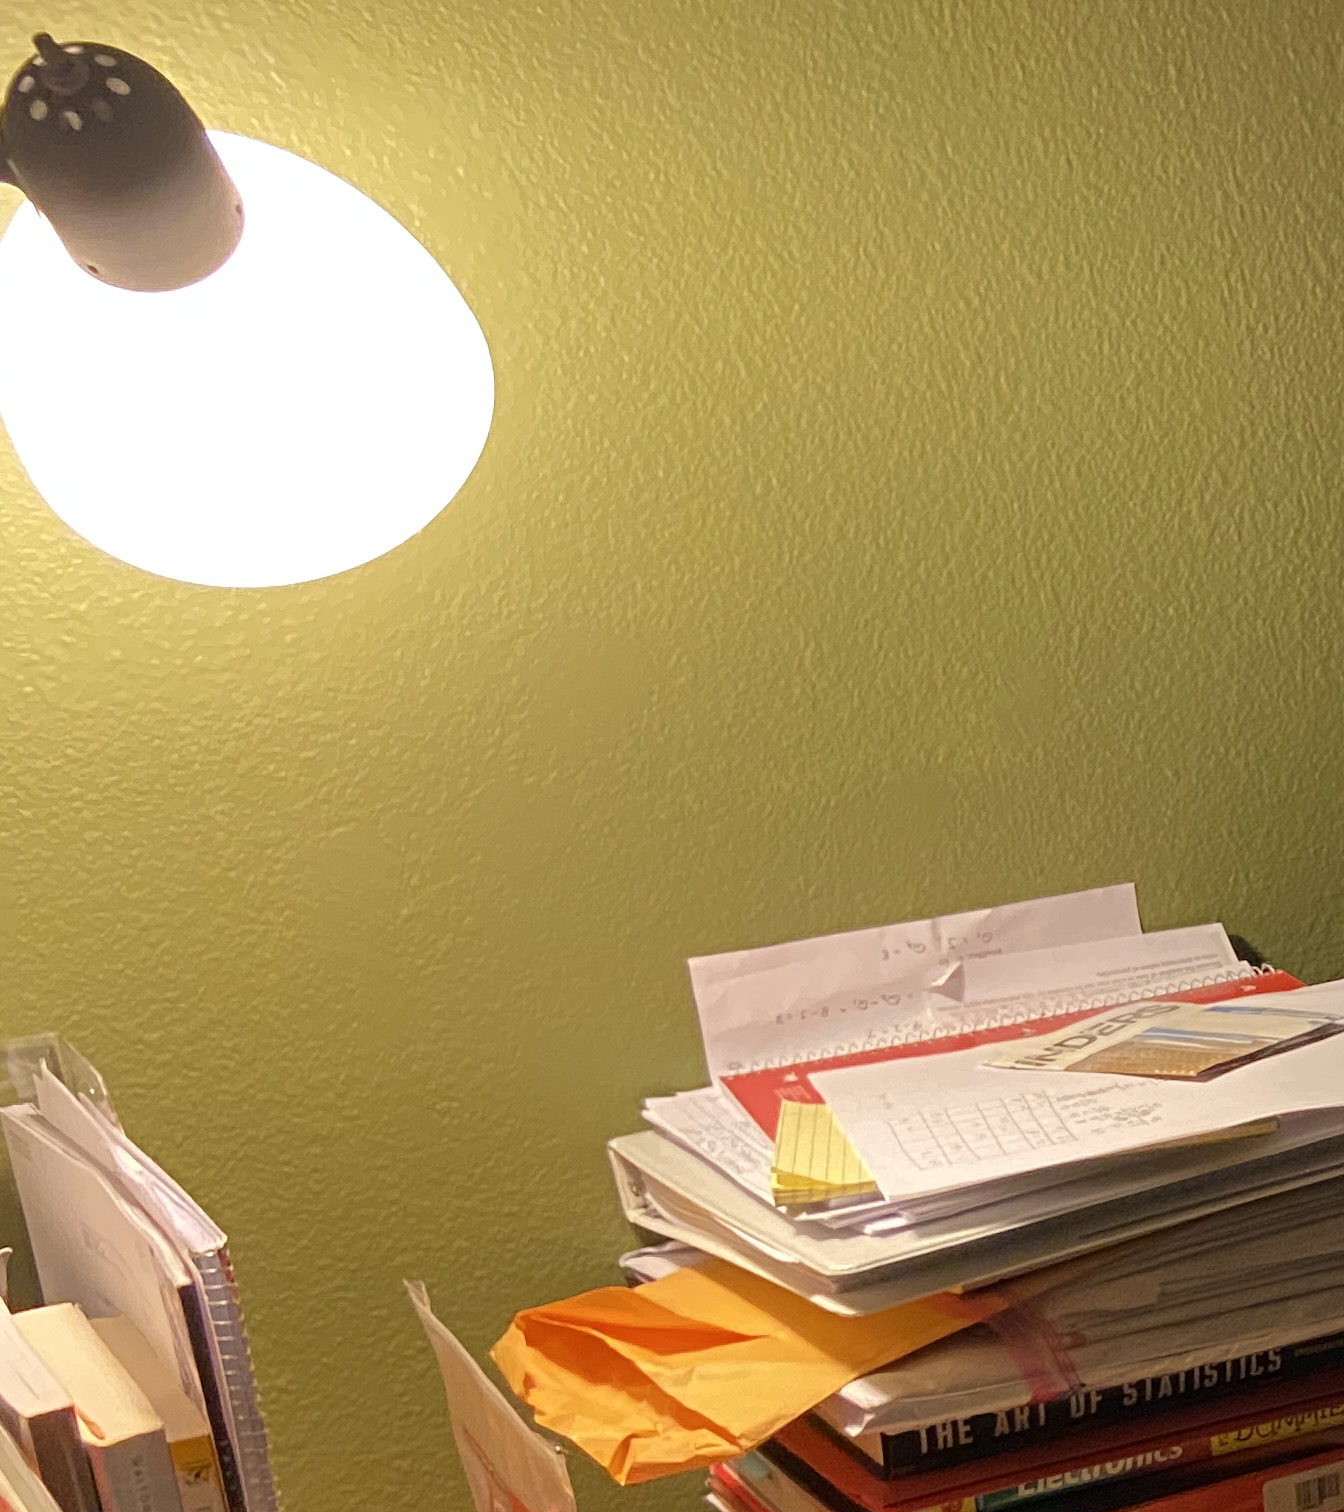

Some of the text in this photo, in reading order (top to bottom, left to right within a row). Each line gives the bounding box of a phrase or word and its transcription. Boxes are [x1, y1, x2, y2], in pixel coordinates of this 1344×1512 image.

[919, 1422, 974, 1454] THE
[994, 1401, 1047, 1436] ART
[1122, 1347, 1283, 1407] STATISTICS
